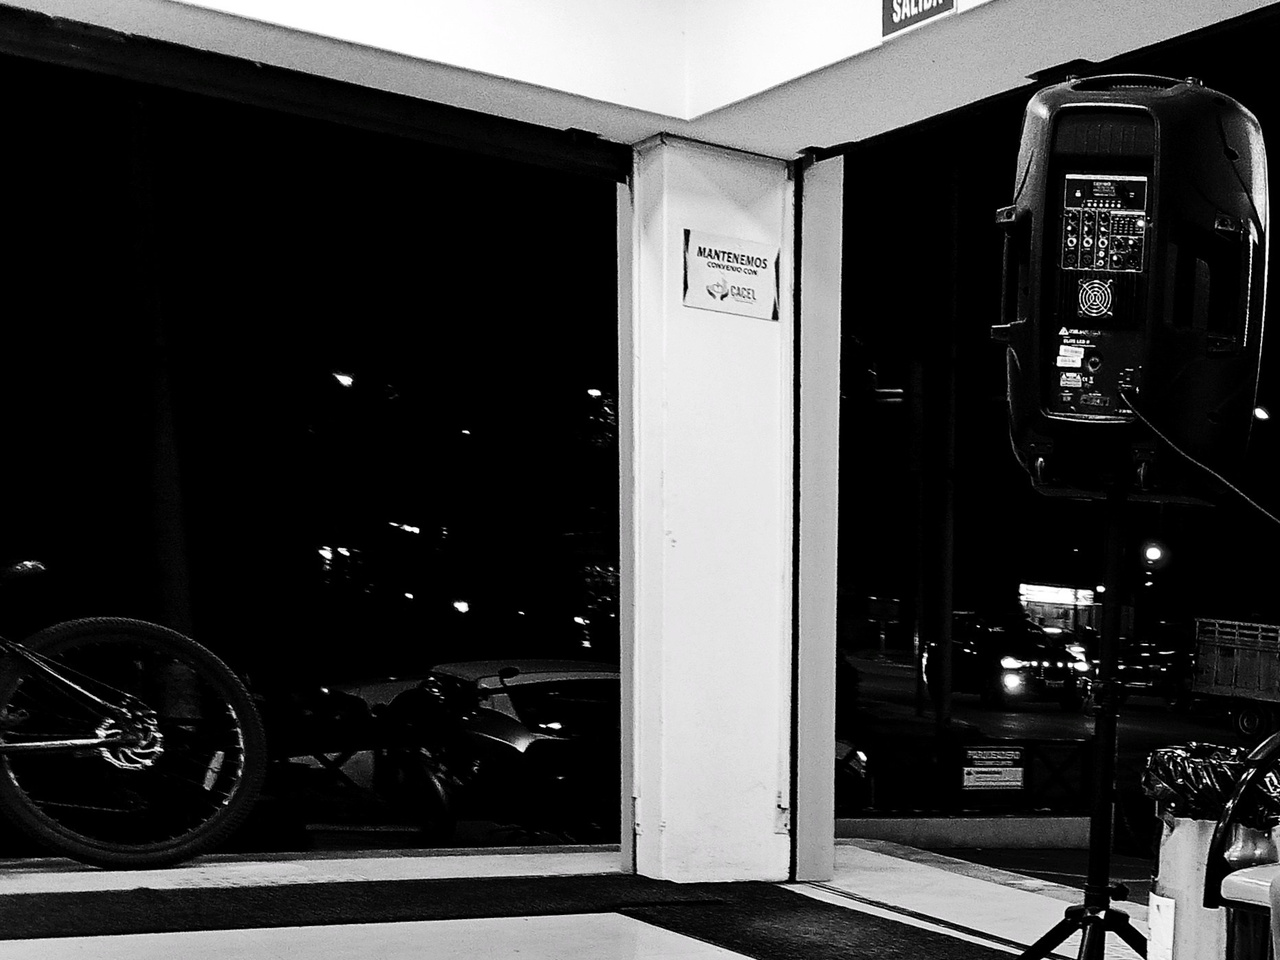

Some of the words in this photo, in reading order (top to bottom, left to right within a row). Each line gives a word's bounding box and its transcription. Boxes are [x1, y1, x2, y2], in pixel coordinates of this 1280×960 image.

[893, 0, 943, 23] SALI
[696, 246, 768, 270] MANTENEMOS
[707, 261, 743, 274] CONVENIO
[743, 267, 759, 276] CON
